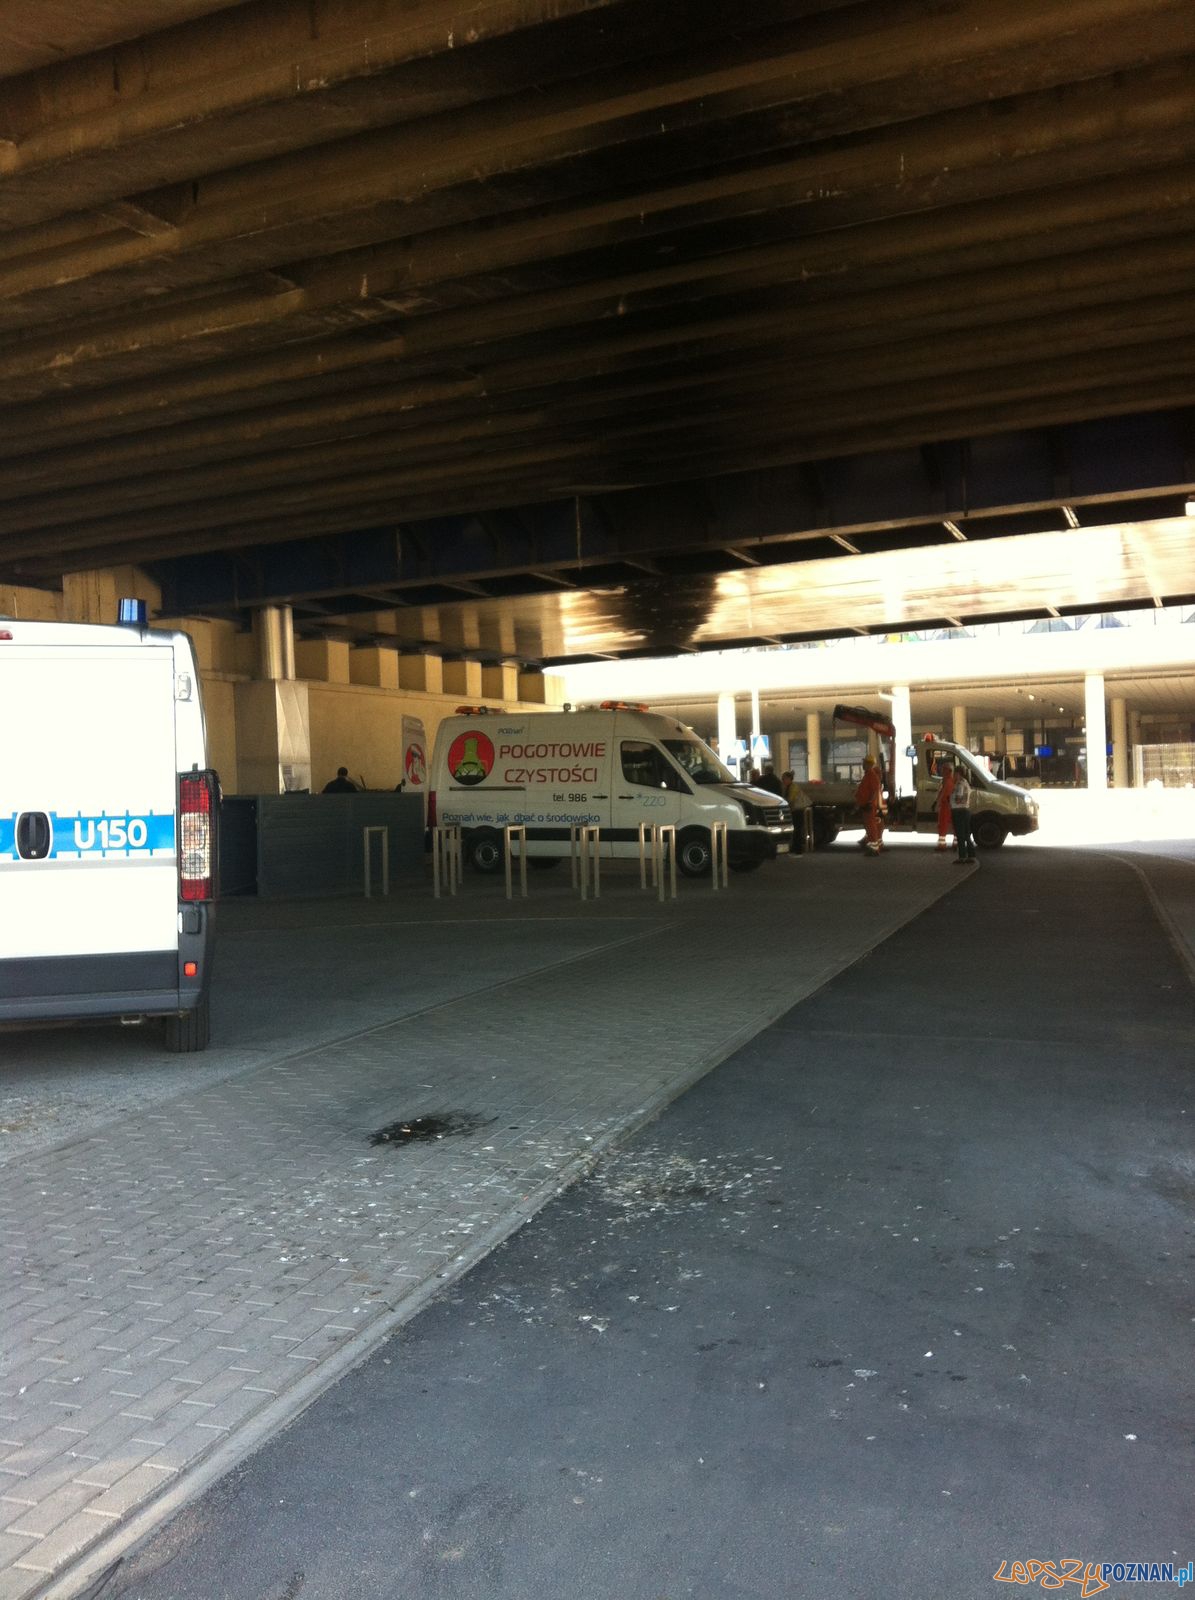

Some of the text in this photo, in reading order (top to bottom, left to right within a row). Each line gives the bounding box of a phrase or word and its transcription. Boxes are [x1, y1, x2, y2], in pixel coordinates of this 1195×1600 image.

[499, 742, 606, 759] POGOTOWIE
[504, 764, 598, 783] CZYSTOŚCI
[553, 793, 587, 803] tel. 986
[442, 812, 475, 822] Poznań
[495, 812, 509, 823] jak
[514, 812, 536, 823] dbać
[537, 814, 545, 823] o
[545, 812, 601, 823] środowisko
[73, 818, 148, 849] U150
